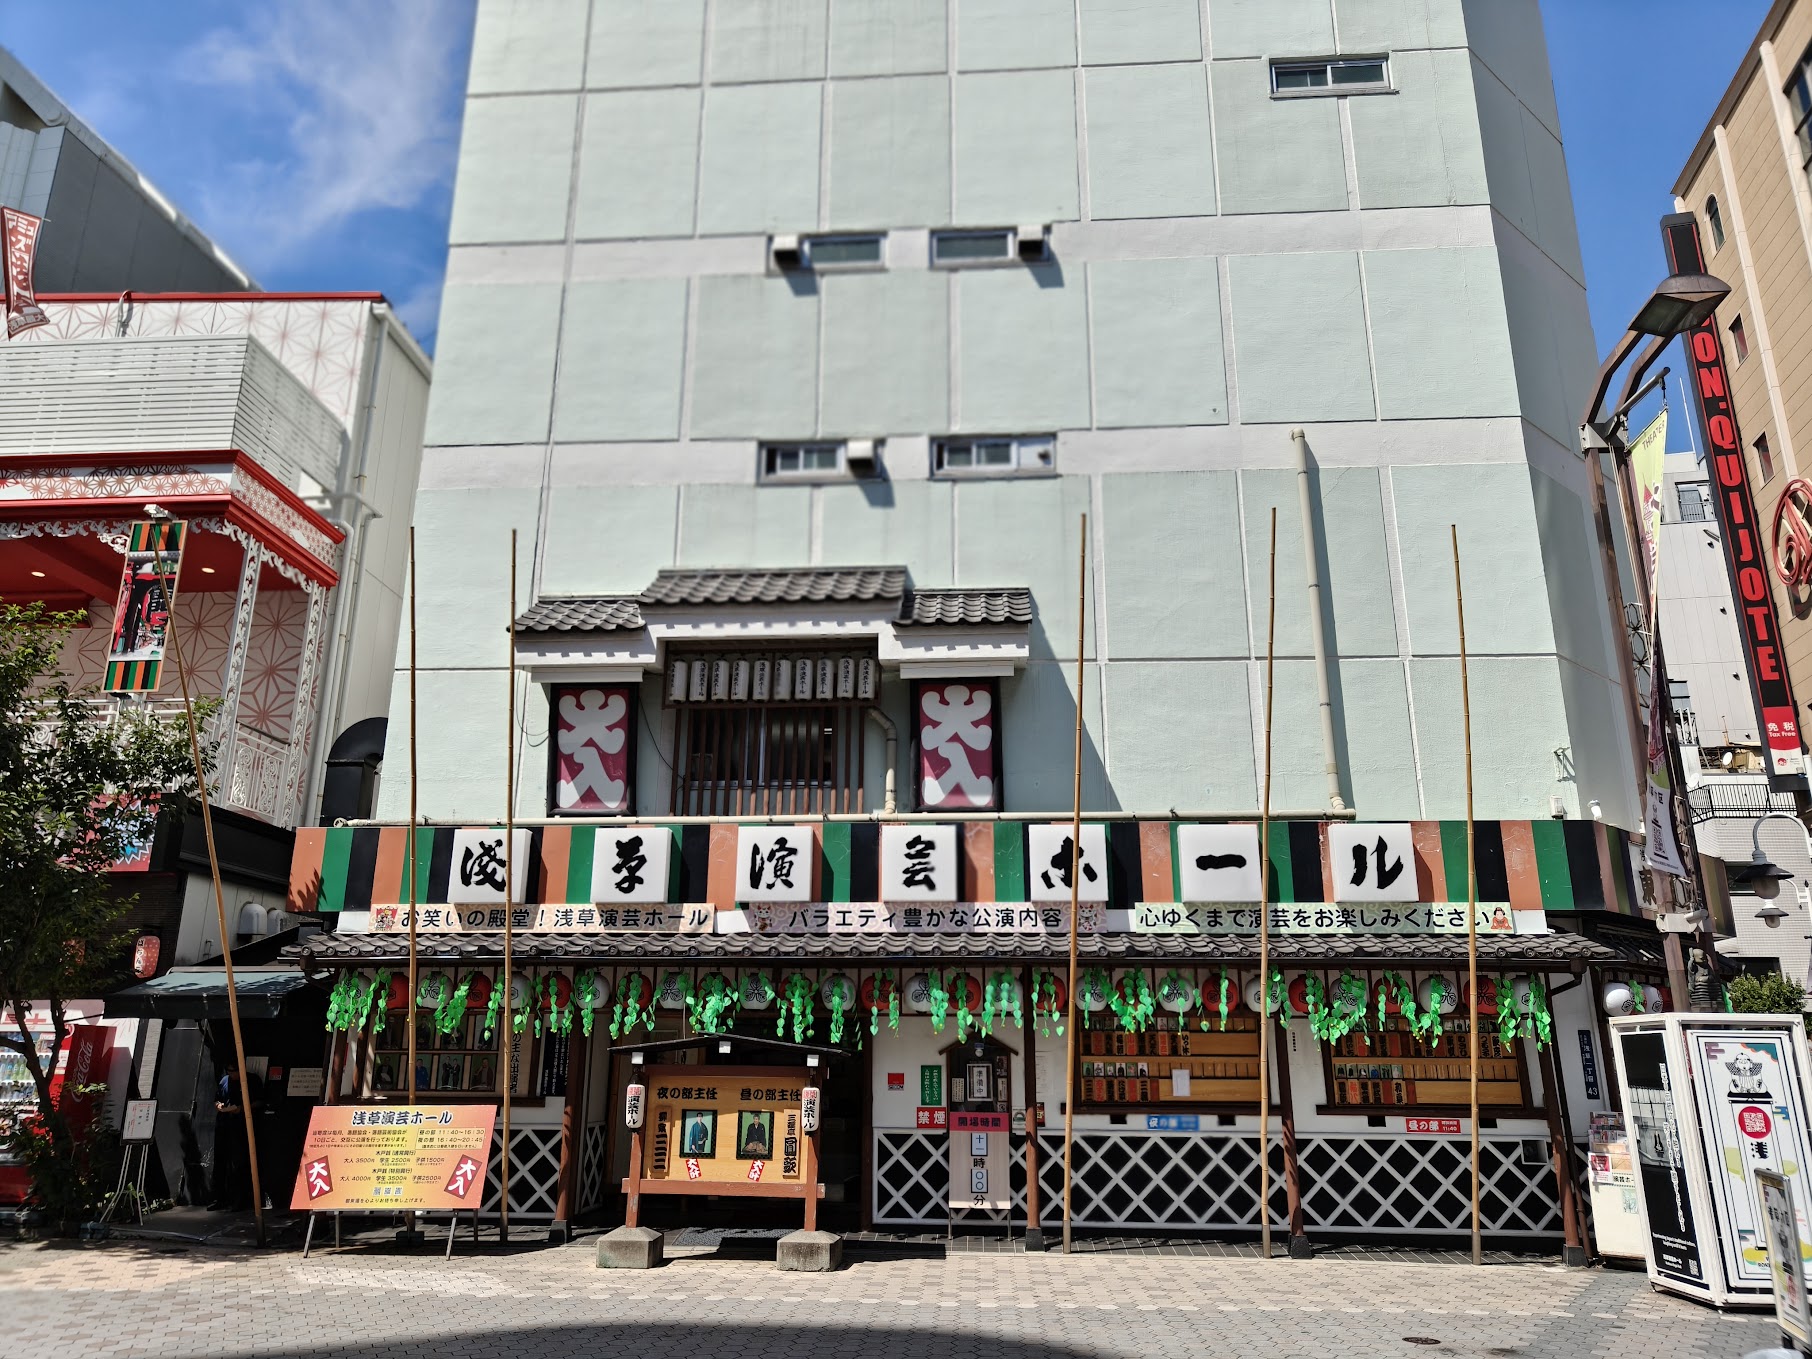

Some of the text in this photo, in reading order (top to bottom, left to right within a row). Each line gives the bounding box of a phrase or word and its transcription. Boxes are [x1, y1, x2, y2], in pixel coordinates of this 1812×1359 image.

[1766, 721, 1796, 732] 免税
[788, 907, 1063, 928] バラエティ豊かな公演内容
[656, 1086, 718, 1100] 夜の部主任
[740, 1088, 802, 1102] 昼の部主任
[1587, 1087, 1598, 1096] 43
[352, 1110, 453, 1126] 浅草演芸ホール
[917, 1110, 946, 1125] 禁煙
[957, 1116, 1002, 1128] 開場時間
[1408, 1119, 1440, 1131] 昼の部
